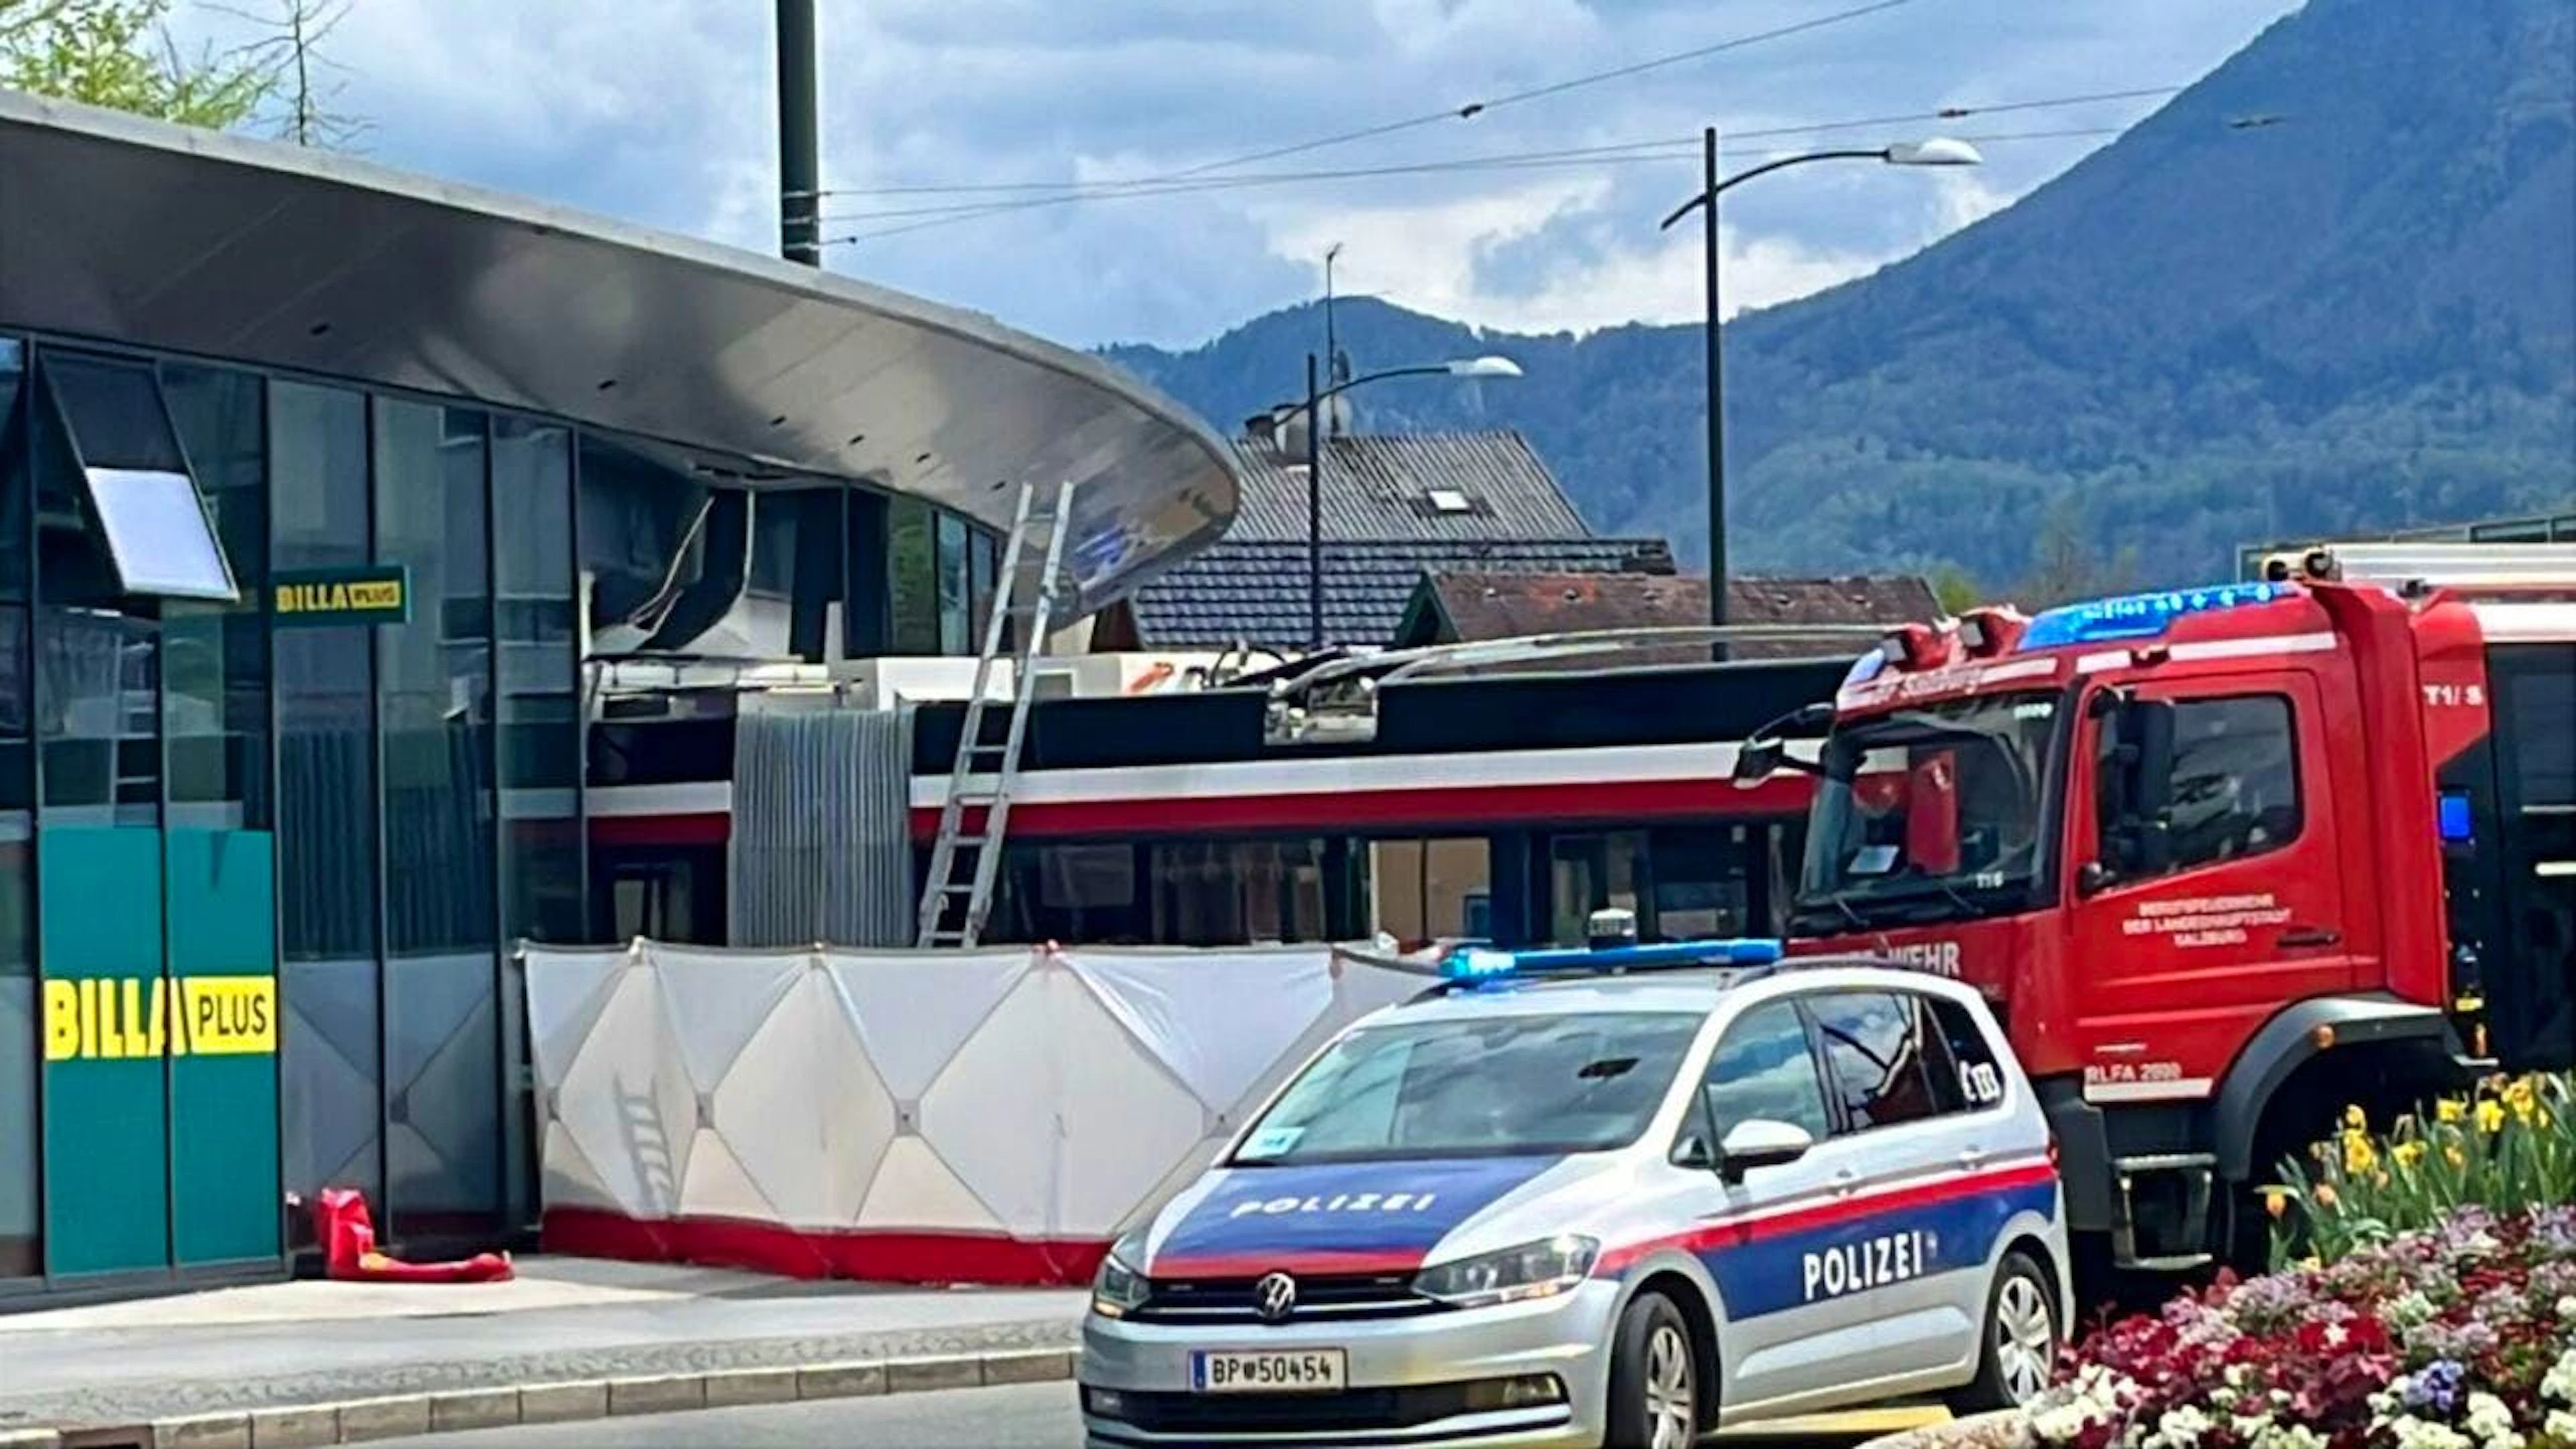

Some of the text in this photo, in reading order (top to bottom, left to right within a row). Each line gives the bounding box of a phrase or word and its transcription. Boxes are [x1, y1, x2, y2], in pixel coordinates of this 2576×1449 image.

[276, 583, 397, 612] BILLA PLUS
[43, 977, 267, 1060] BILLA PLUS
[1230, 1193, 1436, 1219] POLIZEI
[1803, 1230, 1923, 1301] POLIZEI
[1213, 1355, 1332, 1383] BP 50454
